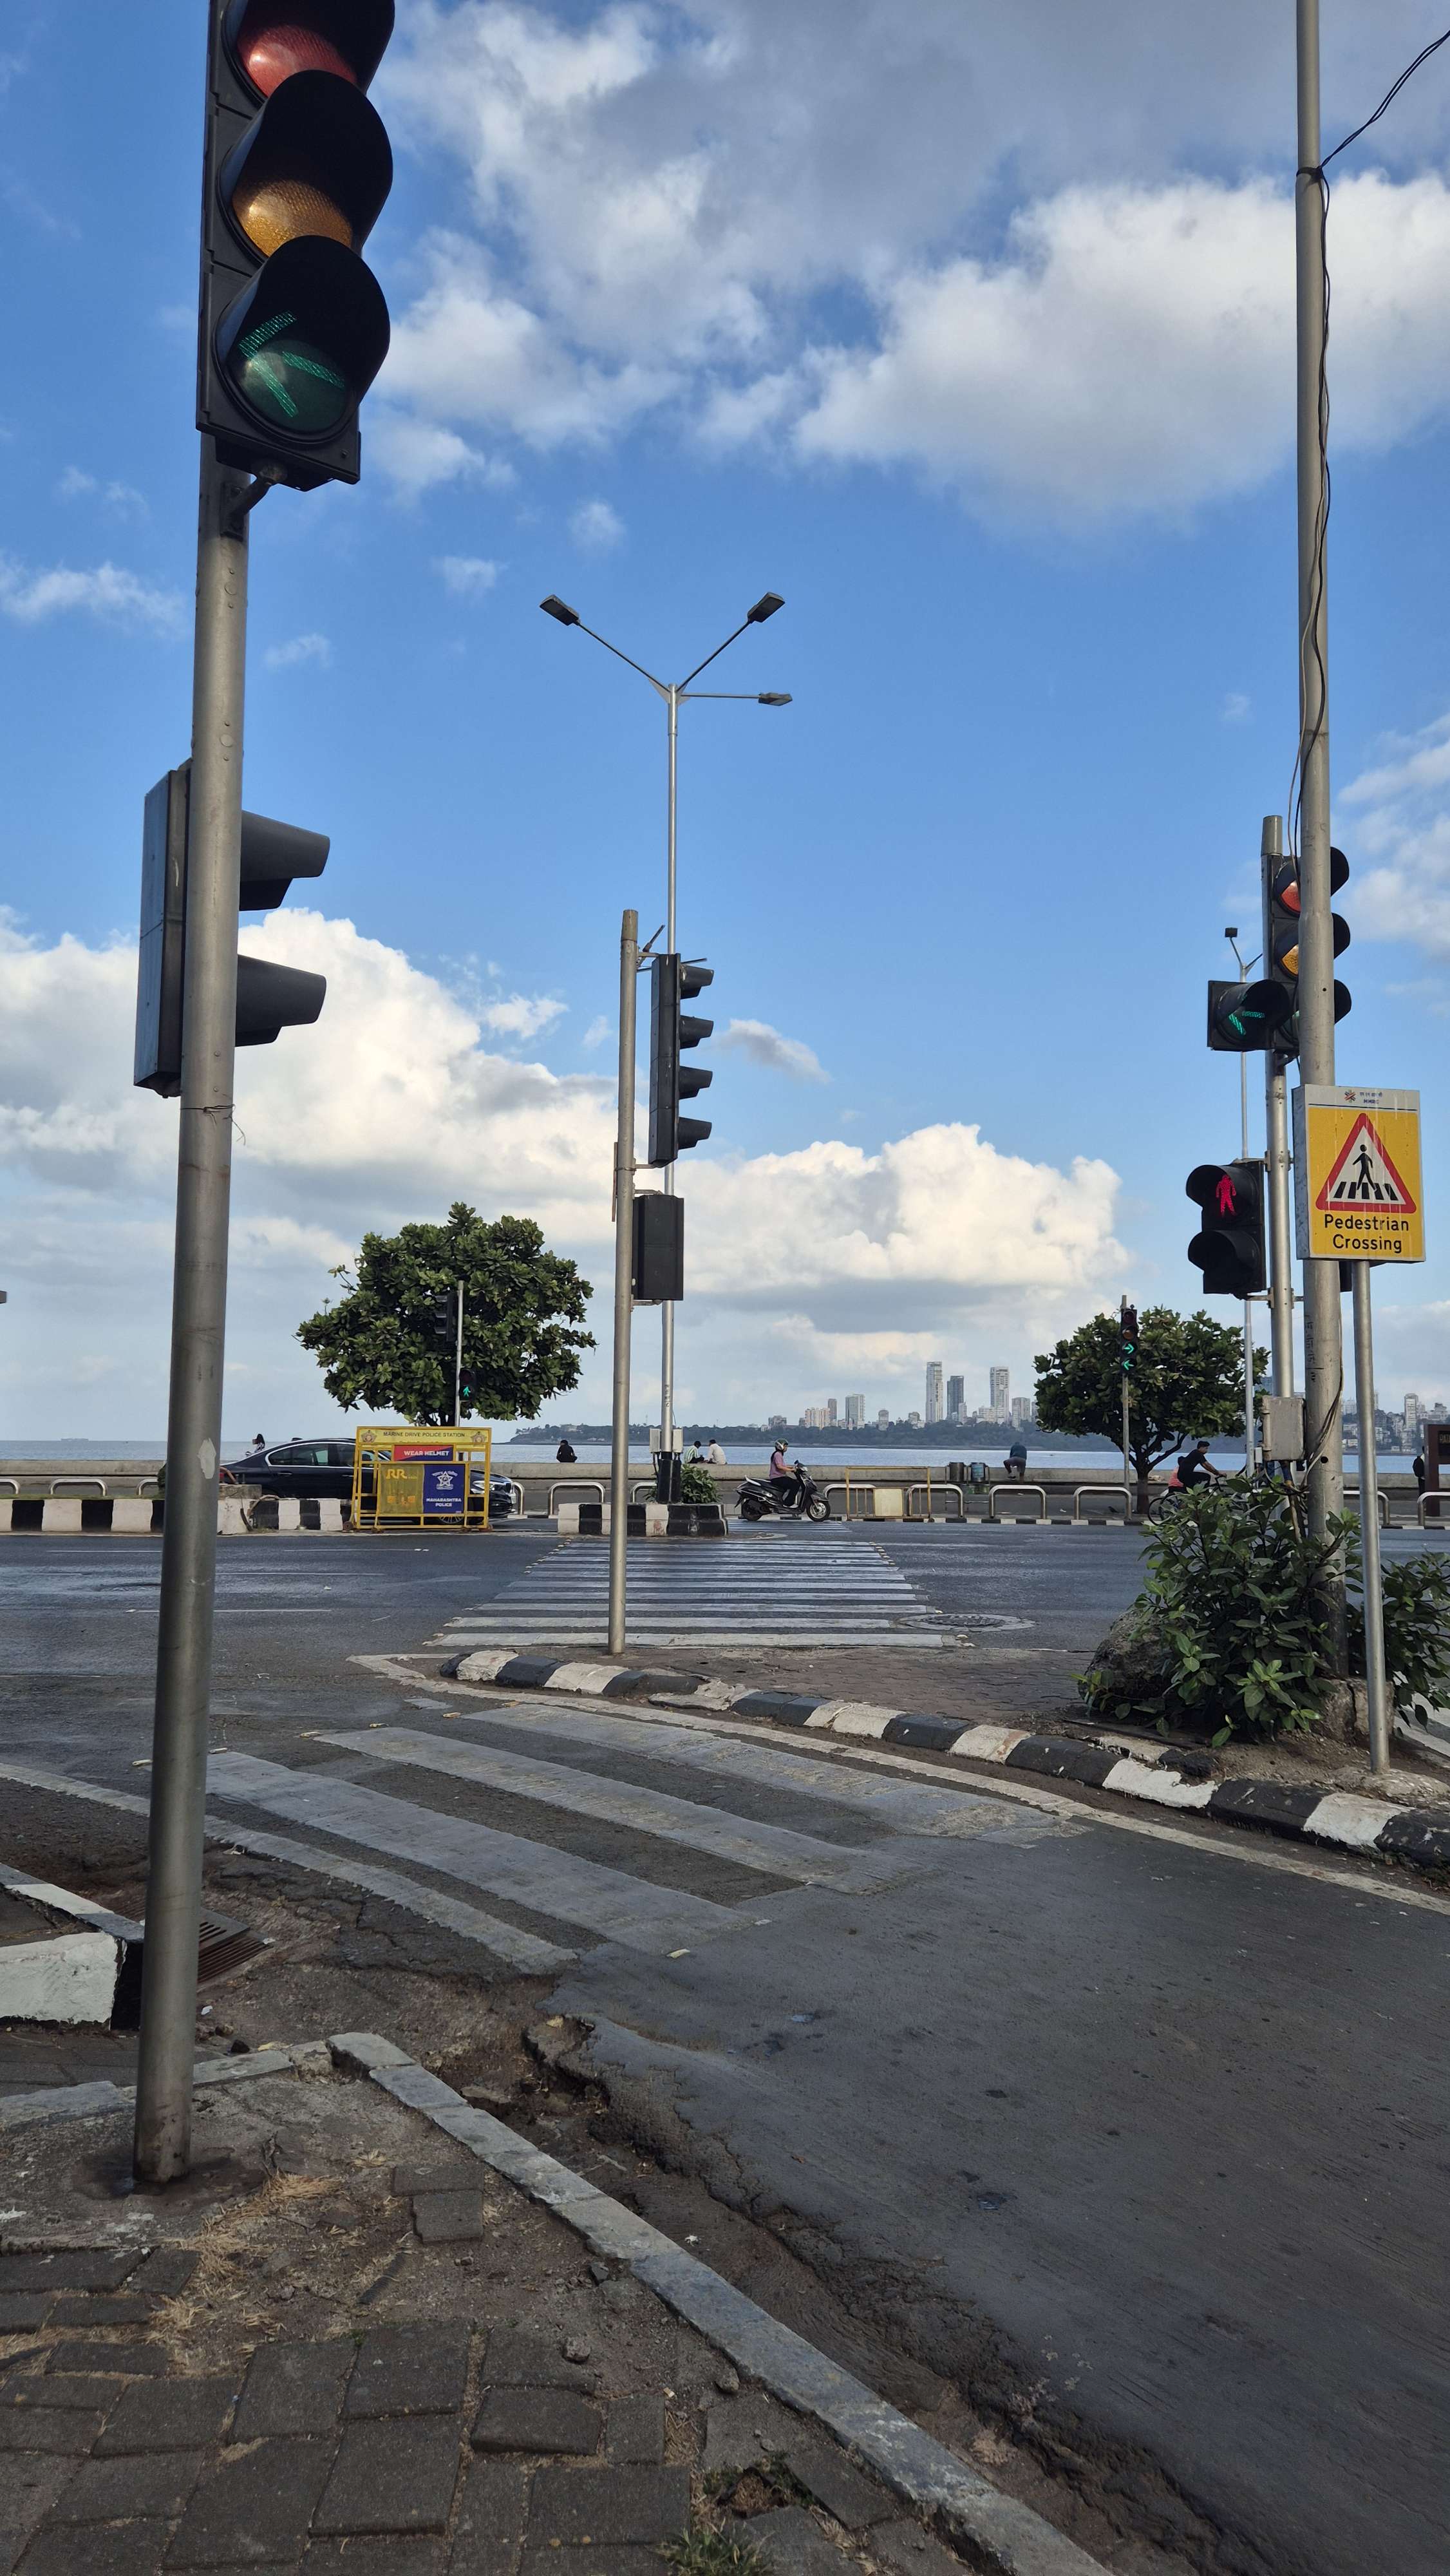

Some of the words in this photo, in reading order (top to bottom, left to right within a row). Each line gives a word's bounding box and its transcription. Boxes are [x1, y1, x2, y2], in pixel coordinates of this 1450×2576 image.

[1324, 1214, 1409, 1231] Pedestrian
[1333, 1234, 1402, 1253] Crossing
[386, 1468, 408, 1479] RR
